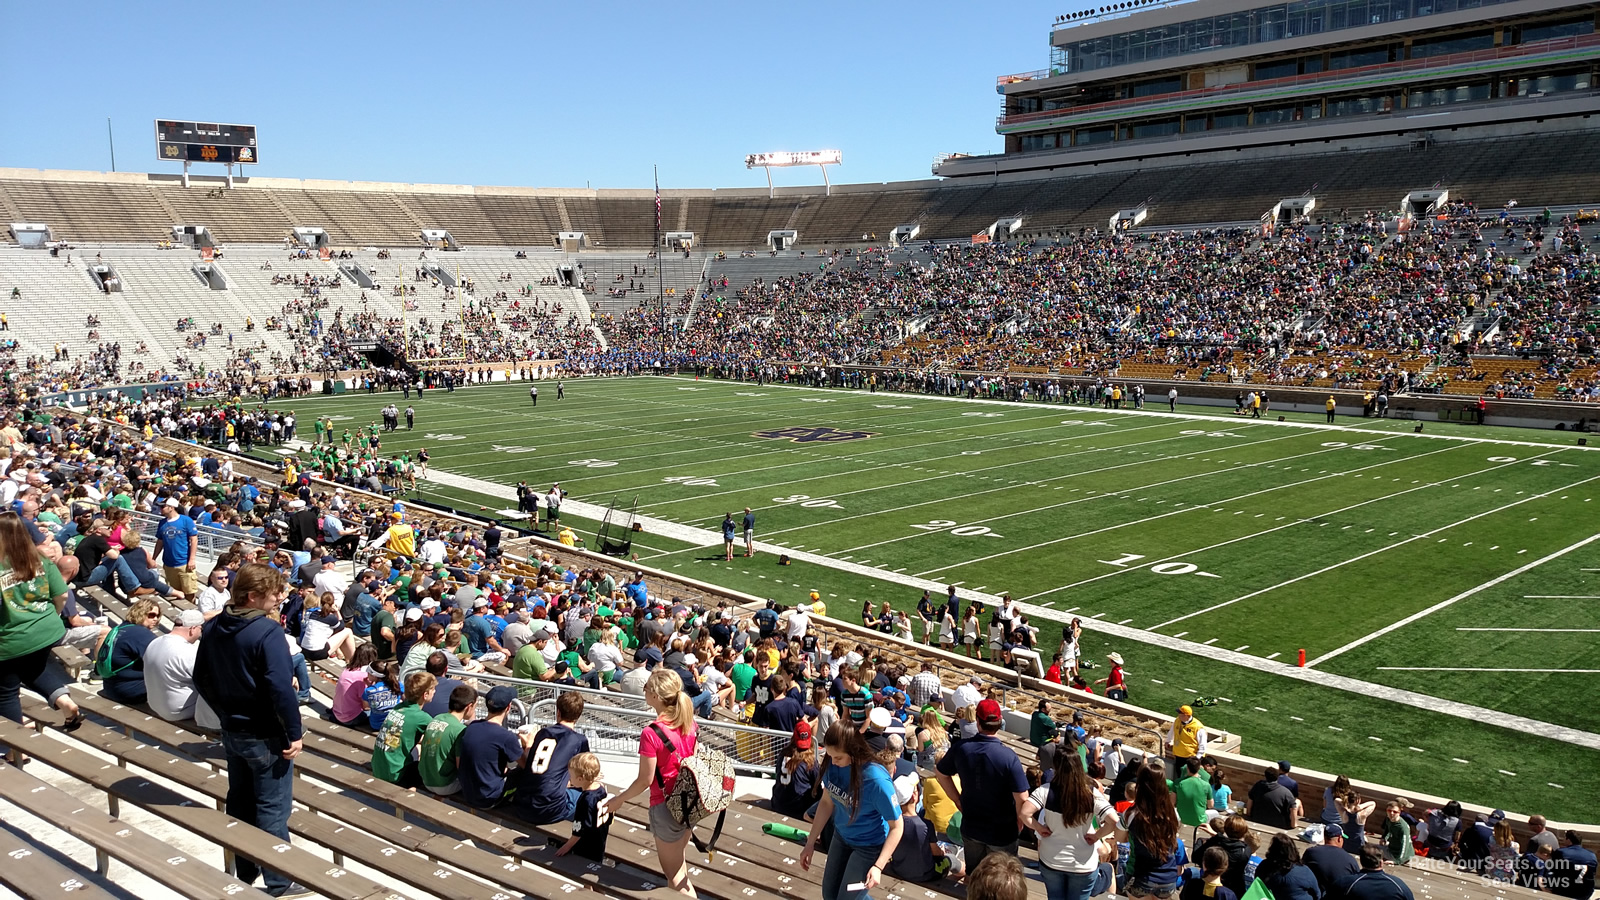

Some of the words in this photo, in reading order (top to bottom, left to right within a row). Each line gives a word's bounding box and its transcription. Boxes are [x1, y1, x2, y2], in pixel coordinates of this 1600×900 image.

[661, 475, 717, 486] 40
[772, 494, 838, 508] 30
[909, 519, 992, 536] 20
[1097, 552, 1198, 576] 10
[531, 738, 557, 775] 8
[1574, 864, 1588, 884] 7
